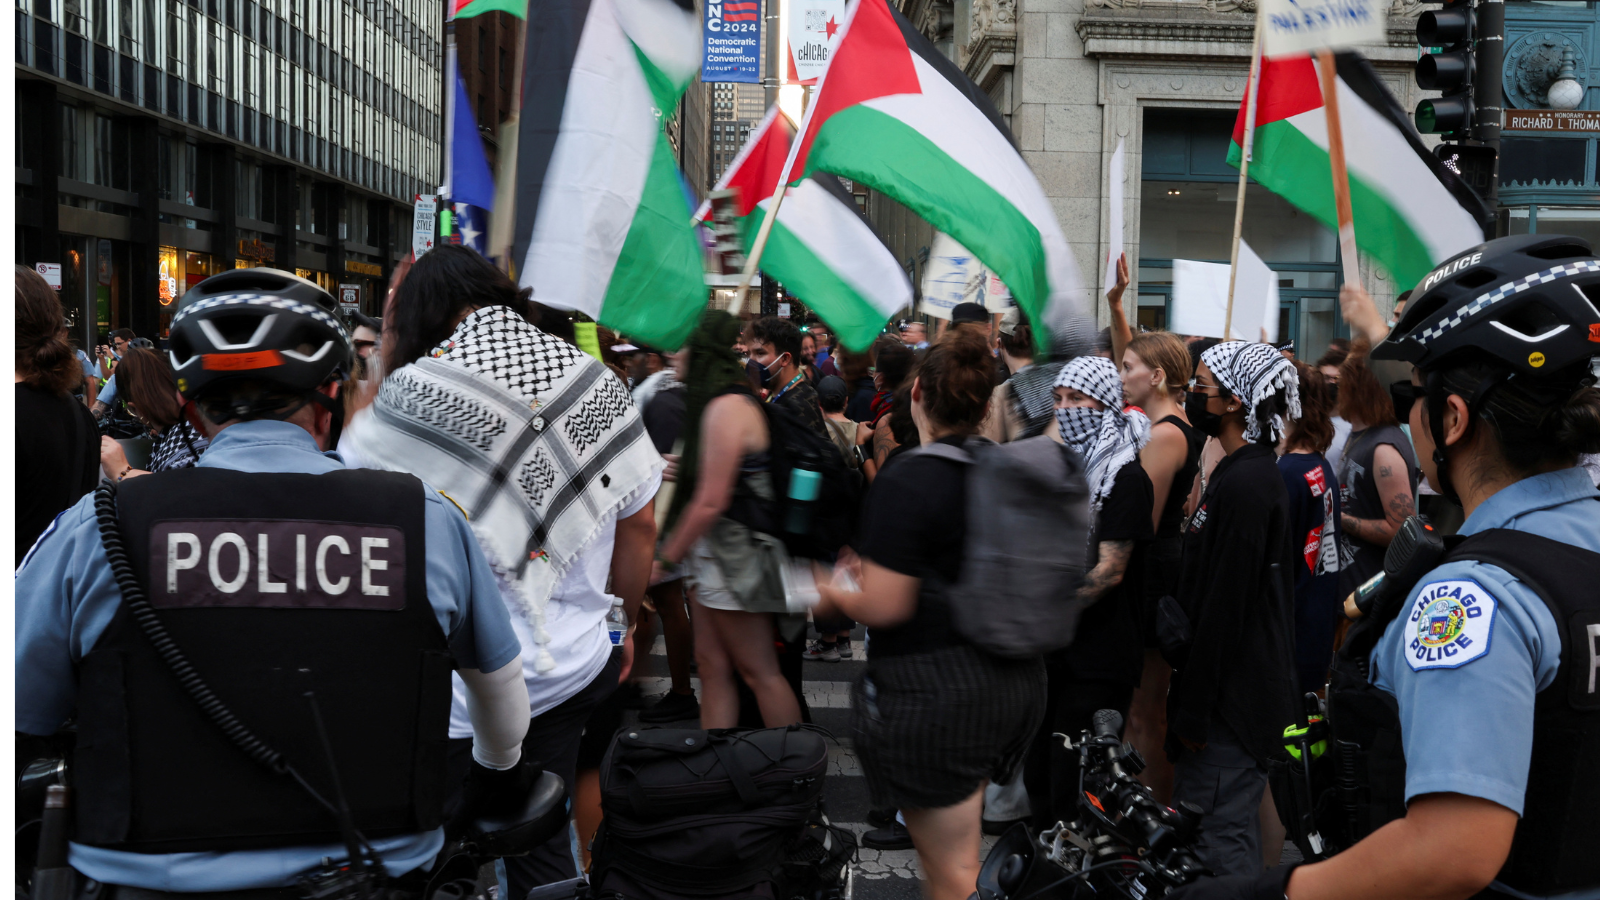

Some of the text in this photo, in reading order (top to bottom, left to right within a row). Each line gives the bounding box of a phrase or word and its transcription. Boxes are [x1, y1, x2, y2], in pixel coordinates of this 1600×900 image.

[723, 23, 757, 32] 2024
[708, 37, 757, 46] Democratic
[707, 46, 742, 54] National
[707, 54, 756, 63] Convention
[1512, 117, 1553, 128] RICHARD
[1558, 119, 1563, 129] L
[416, 220, 432, 231] STYLE
[1424, 252, 1483, 292] POLICE
[167, 532, 390, 595] POLICE
[1411, 585, 1482, 623] CHICAGO
[1410, 634, 1474, 662] POLICE
